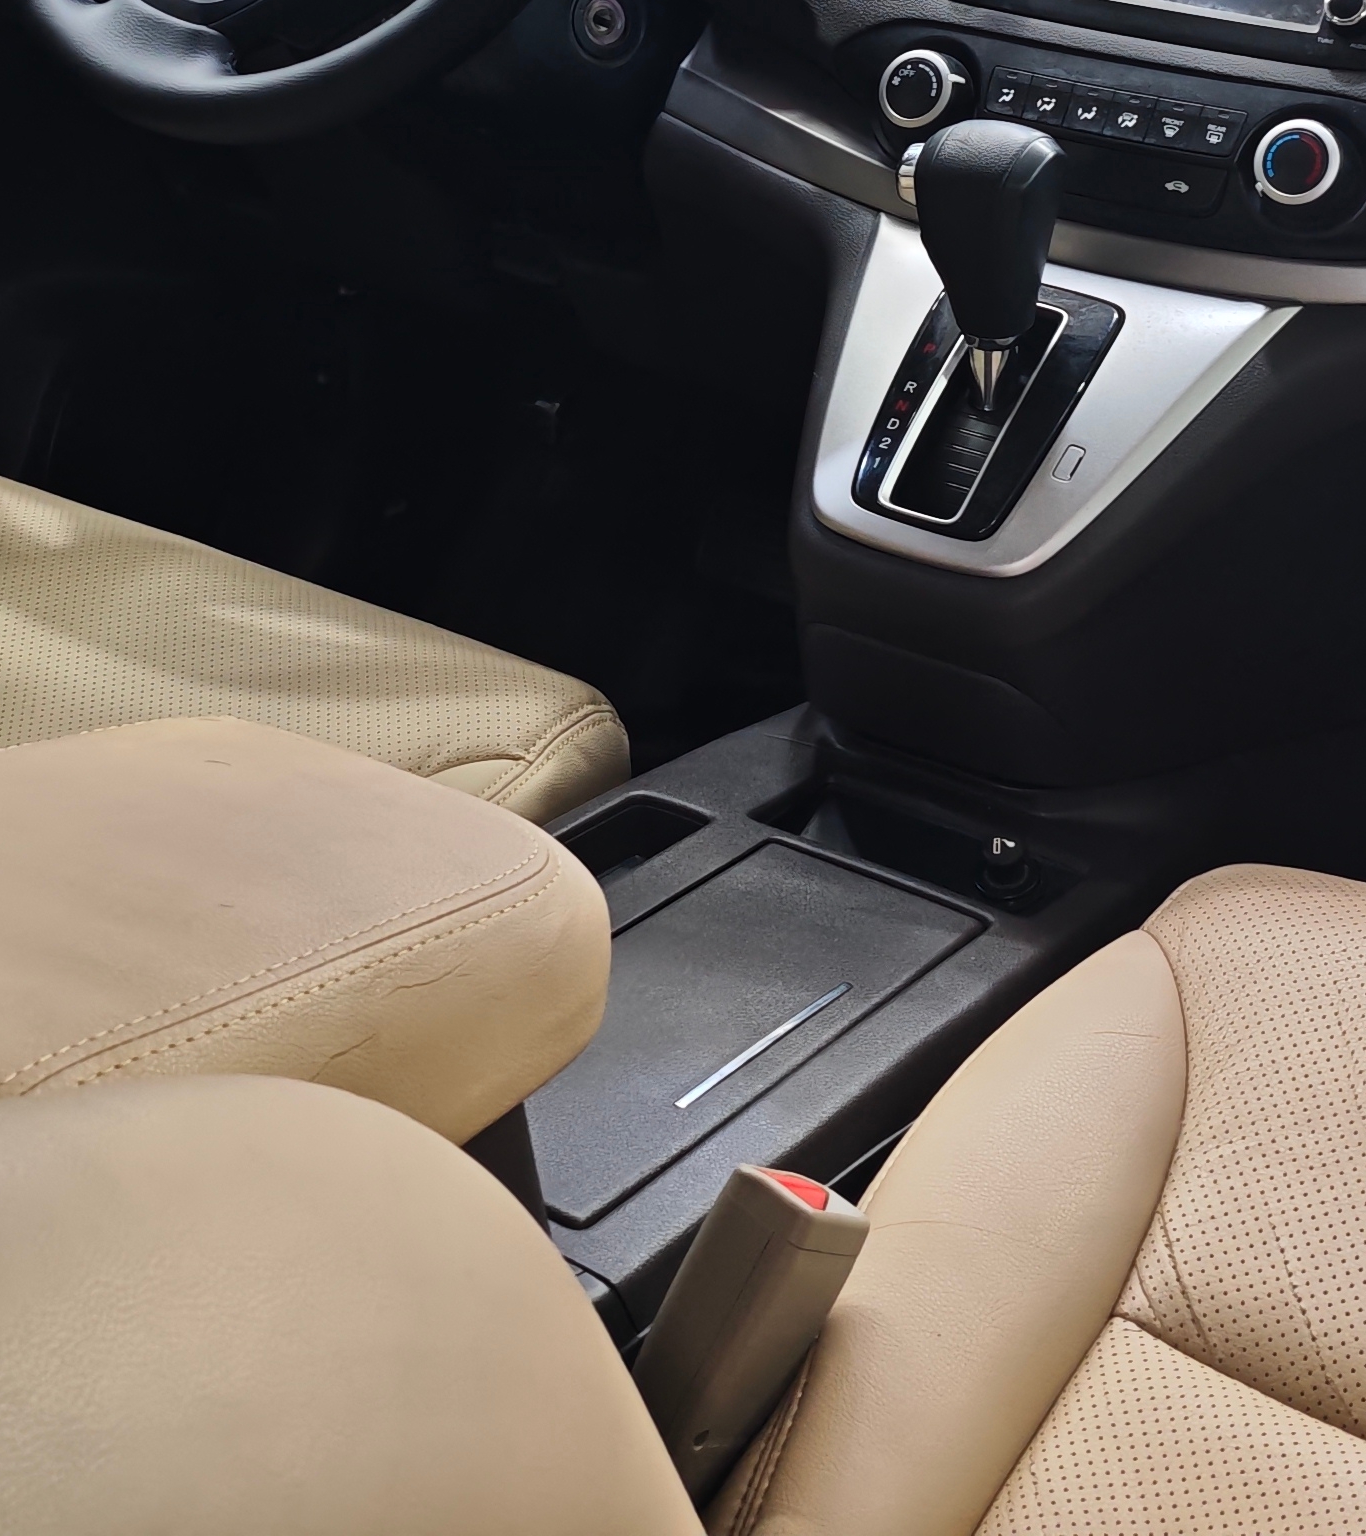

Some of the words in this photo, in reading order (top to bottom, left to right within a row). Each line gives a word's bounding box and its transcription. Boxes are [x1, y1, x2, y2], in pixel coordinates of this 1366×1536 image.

[898, 68, 917, 77] OFF
[1161, 117, 1185, 126] FRONT
[1206, 123, 1227, 133] REAR
[924, 342, 935, 353] P
[903, 380, 917, 393] R
[895, 400, 908, 411] N
[886, 417, 900, 429] D
[878, 437, 892, 449] 2
[873, 456, 881, 468] 1
